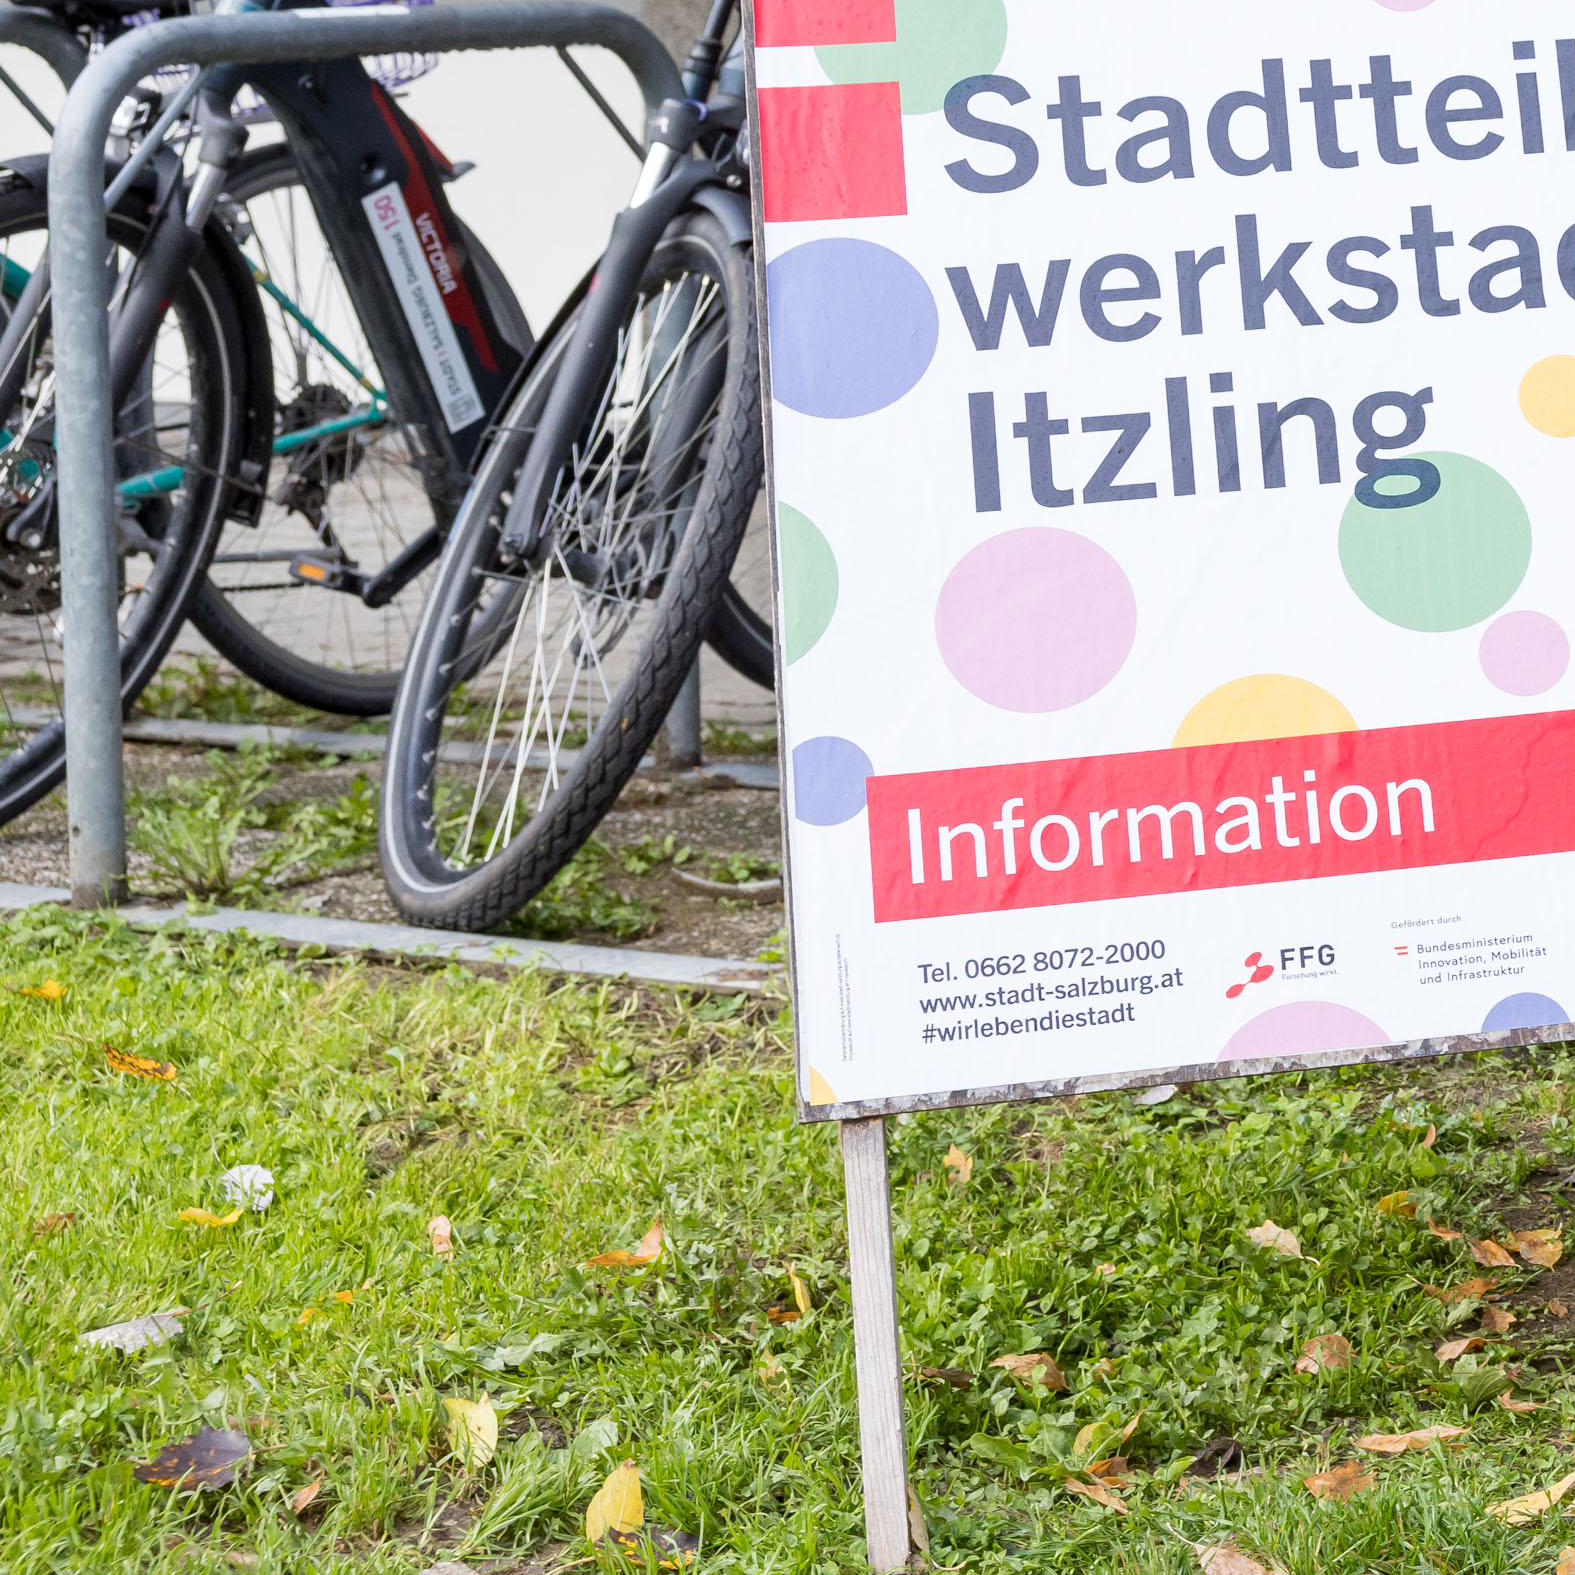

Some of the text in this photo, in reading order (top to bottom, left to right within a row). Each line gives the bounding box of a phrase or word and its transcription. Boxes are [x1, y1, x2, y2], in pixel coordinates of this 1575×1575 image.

[373, 195, 400, 231] 150
[415, 212, 458, 295] VICTORIA
[967, 371, 1442, 514] Itzling
[906, 768, 1437, 886] Information
[1391, 914, 1462, 929] Gefördert durch
[917, 939, 1165, 984] Tel. 0662 8072-2000
[1280, 944, 1335, 970] FFG
[1417, 934, 1533, 954] Bundesministerium
[1418, 947, 1548, 969] Innovation, Mobilität
[919, 968, 1184, 1014] www.stadt-salzburg.at
[1281, 970, 1318, 981] Forschung
[1419, 965, 1525, 984] und Infrastruktur
[922, 1002, 1136, 1044] #wirlebendiestadt
